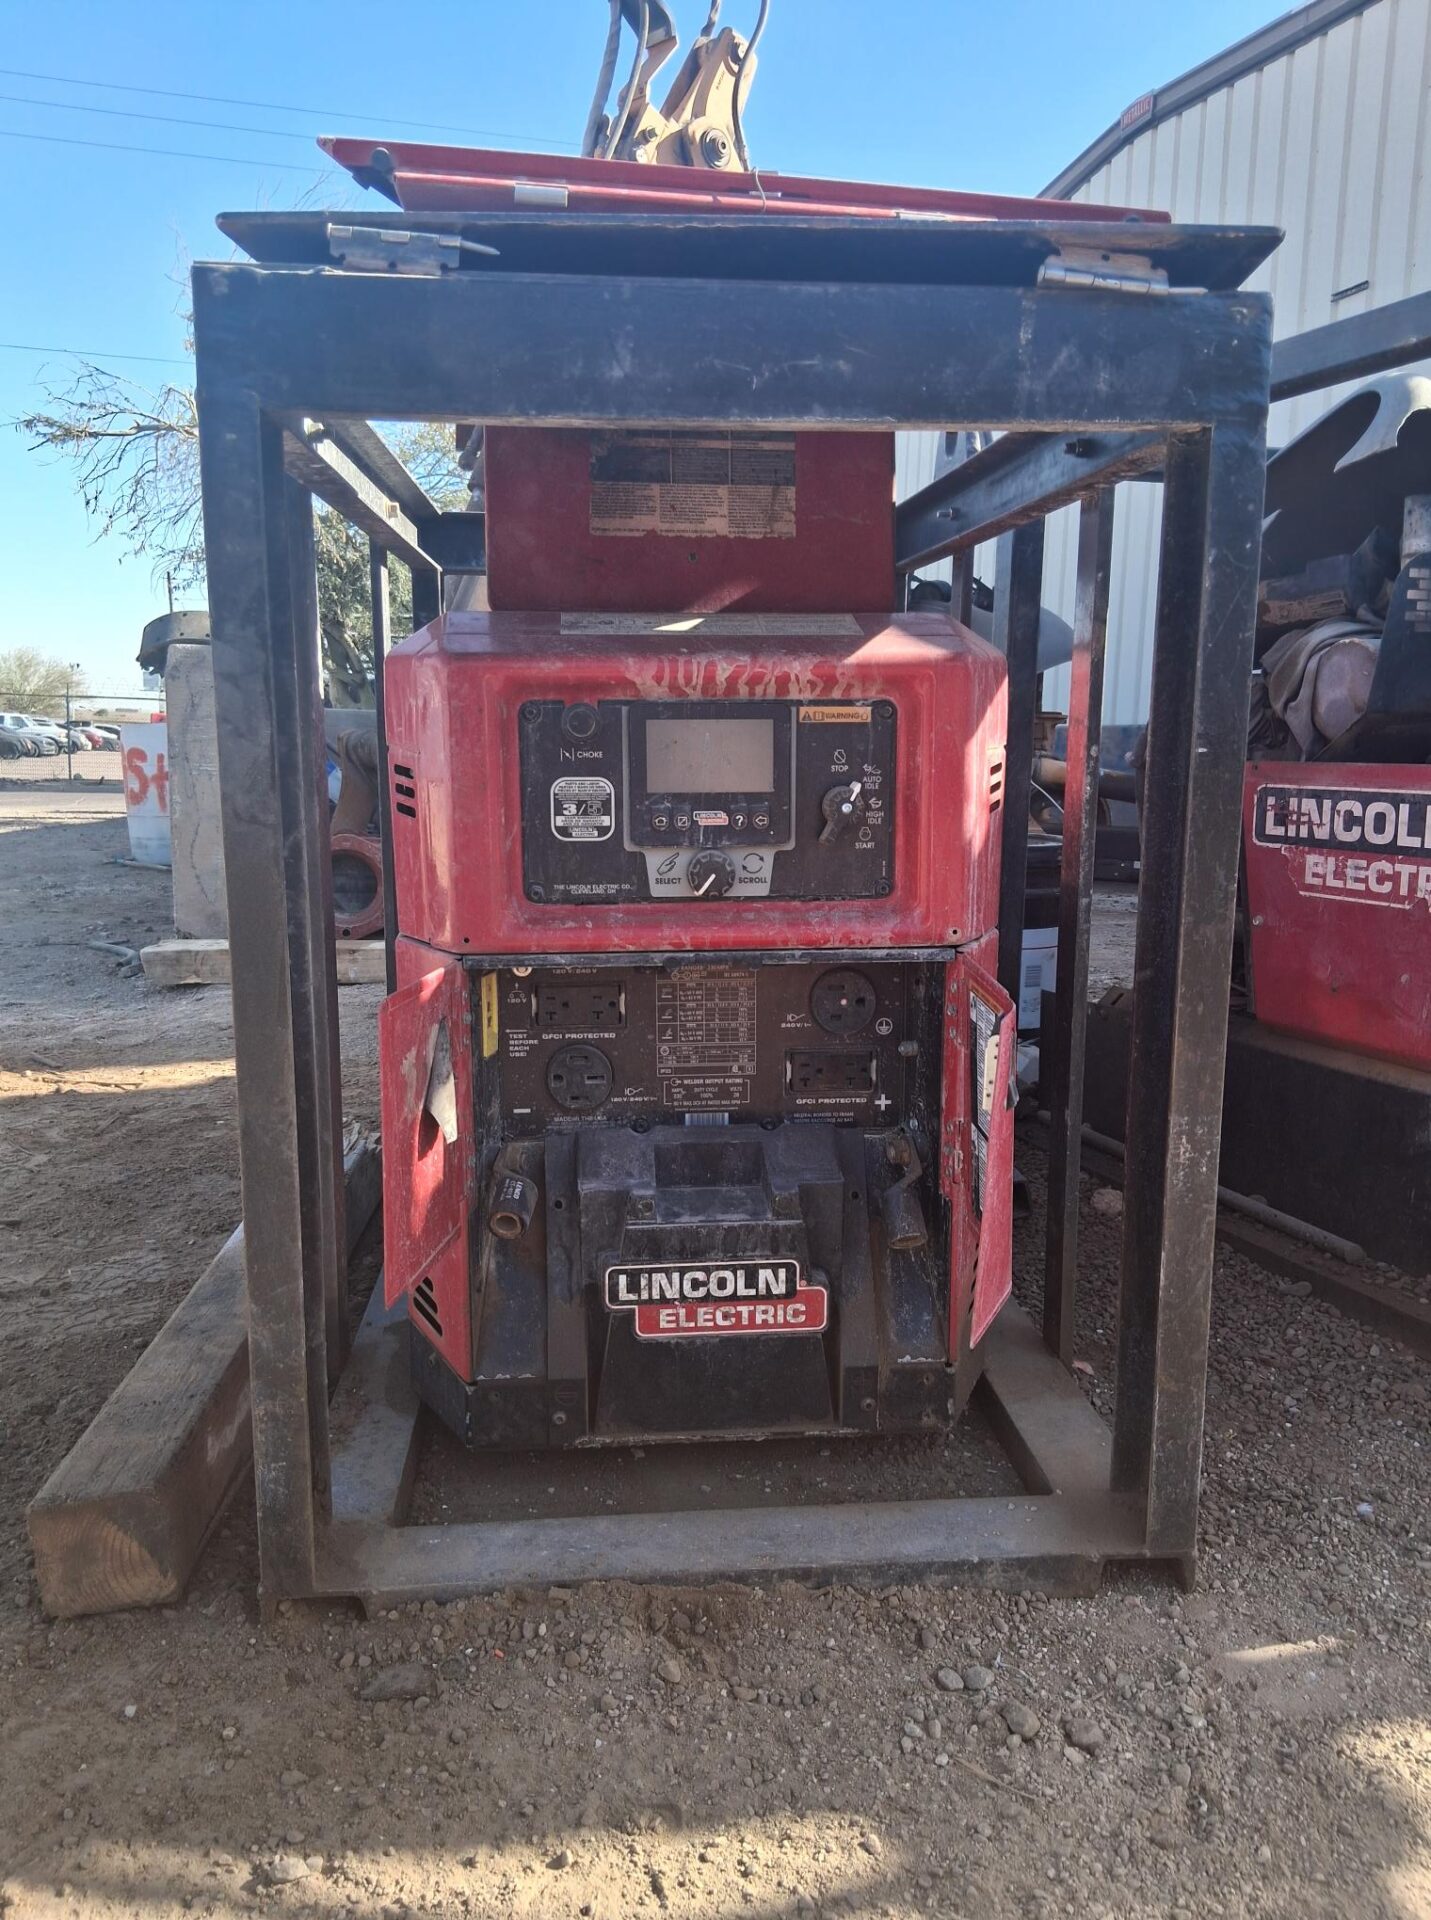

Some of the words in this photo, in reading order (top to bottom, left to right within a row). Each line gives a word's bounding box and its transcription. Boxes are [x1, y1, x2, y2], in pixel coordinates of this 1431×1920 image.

[826, 712, 860, 720] WARNING
[1265, 796, 1431, 848] LINCOL
[618, 1268, 787, 1300] LINCOLN
[659, 1304, 806, 1329] ELECTRIC
